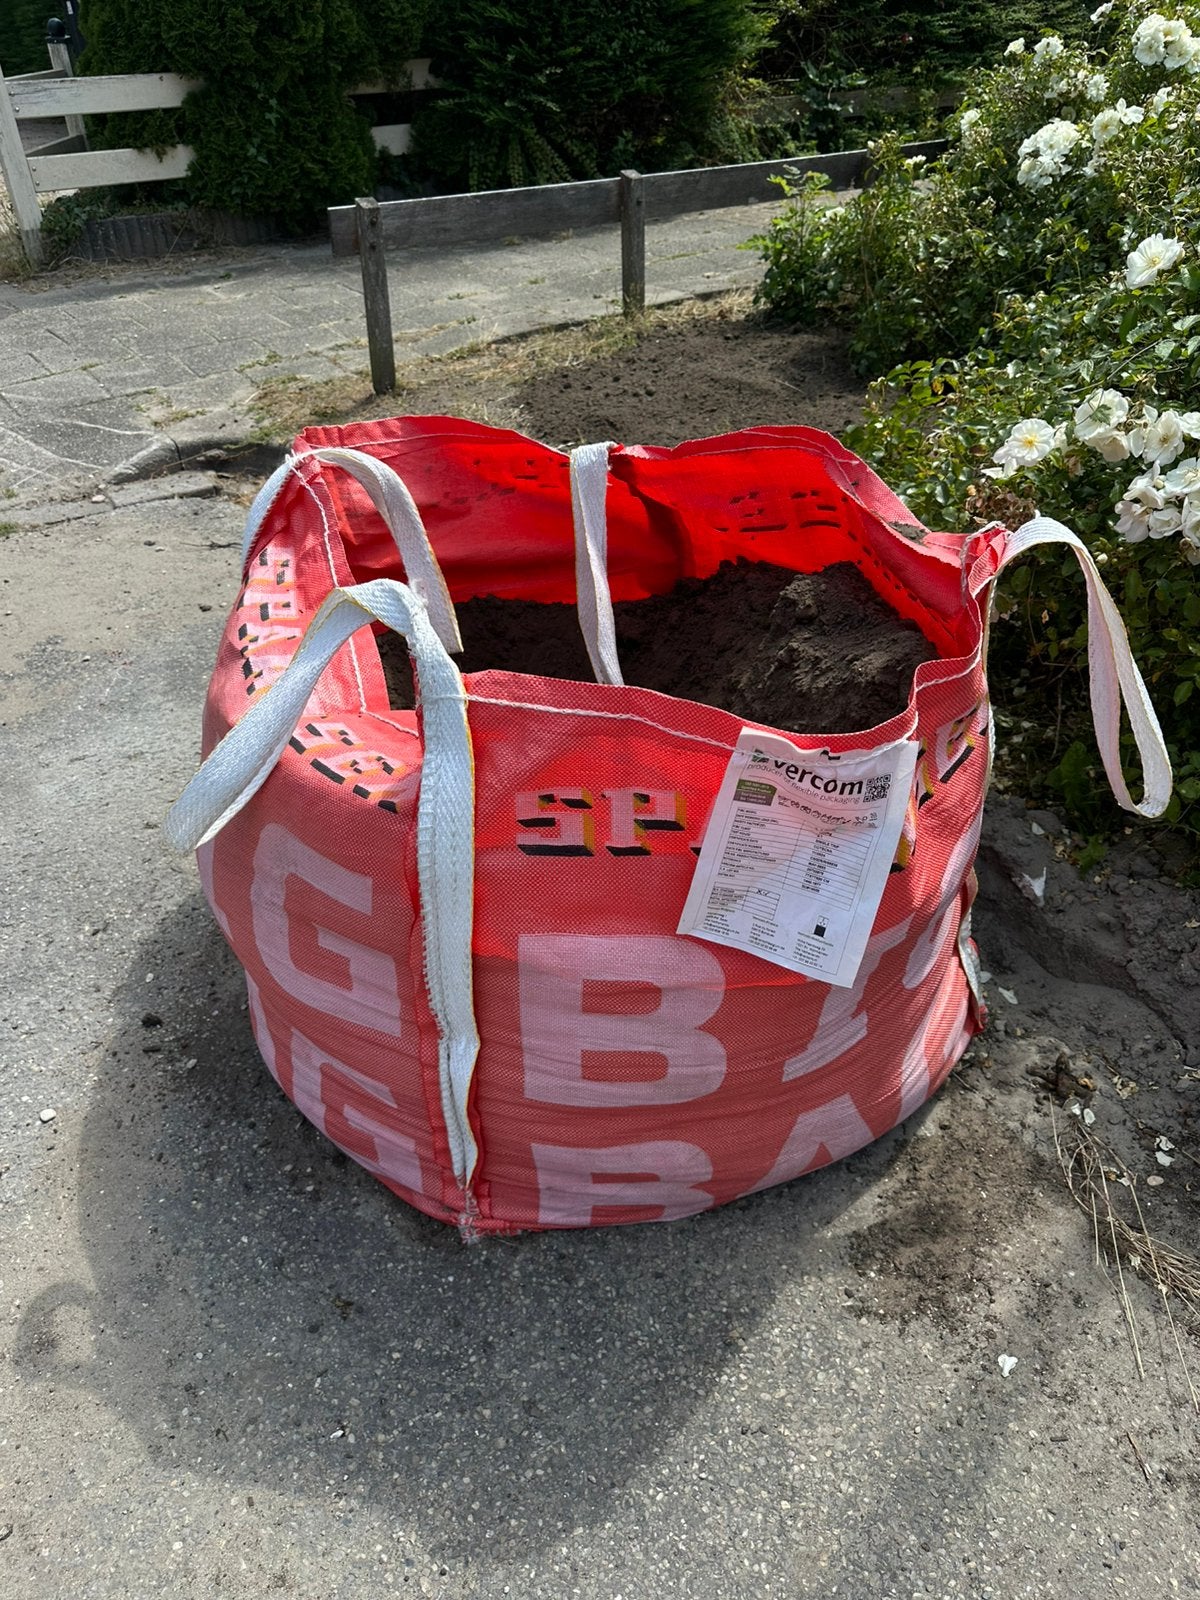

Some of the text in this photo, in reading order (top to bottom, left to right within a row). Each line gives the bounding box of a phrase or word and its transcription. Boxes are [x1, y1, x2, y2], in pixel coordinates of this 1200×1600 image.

[747, 763, 783, 778] producer
[791, 782, 819, 799] flexible
[820, 794, 861, 806] packaging
